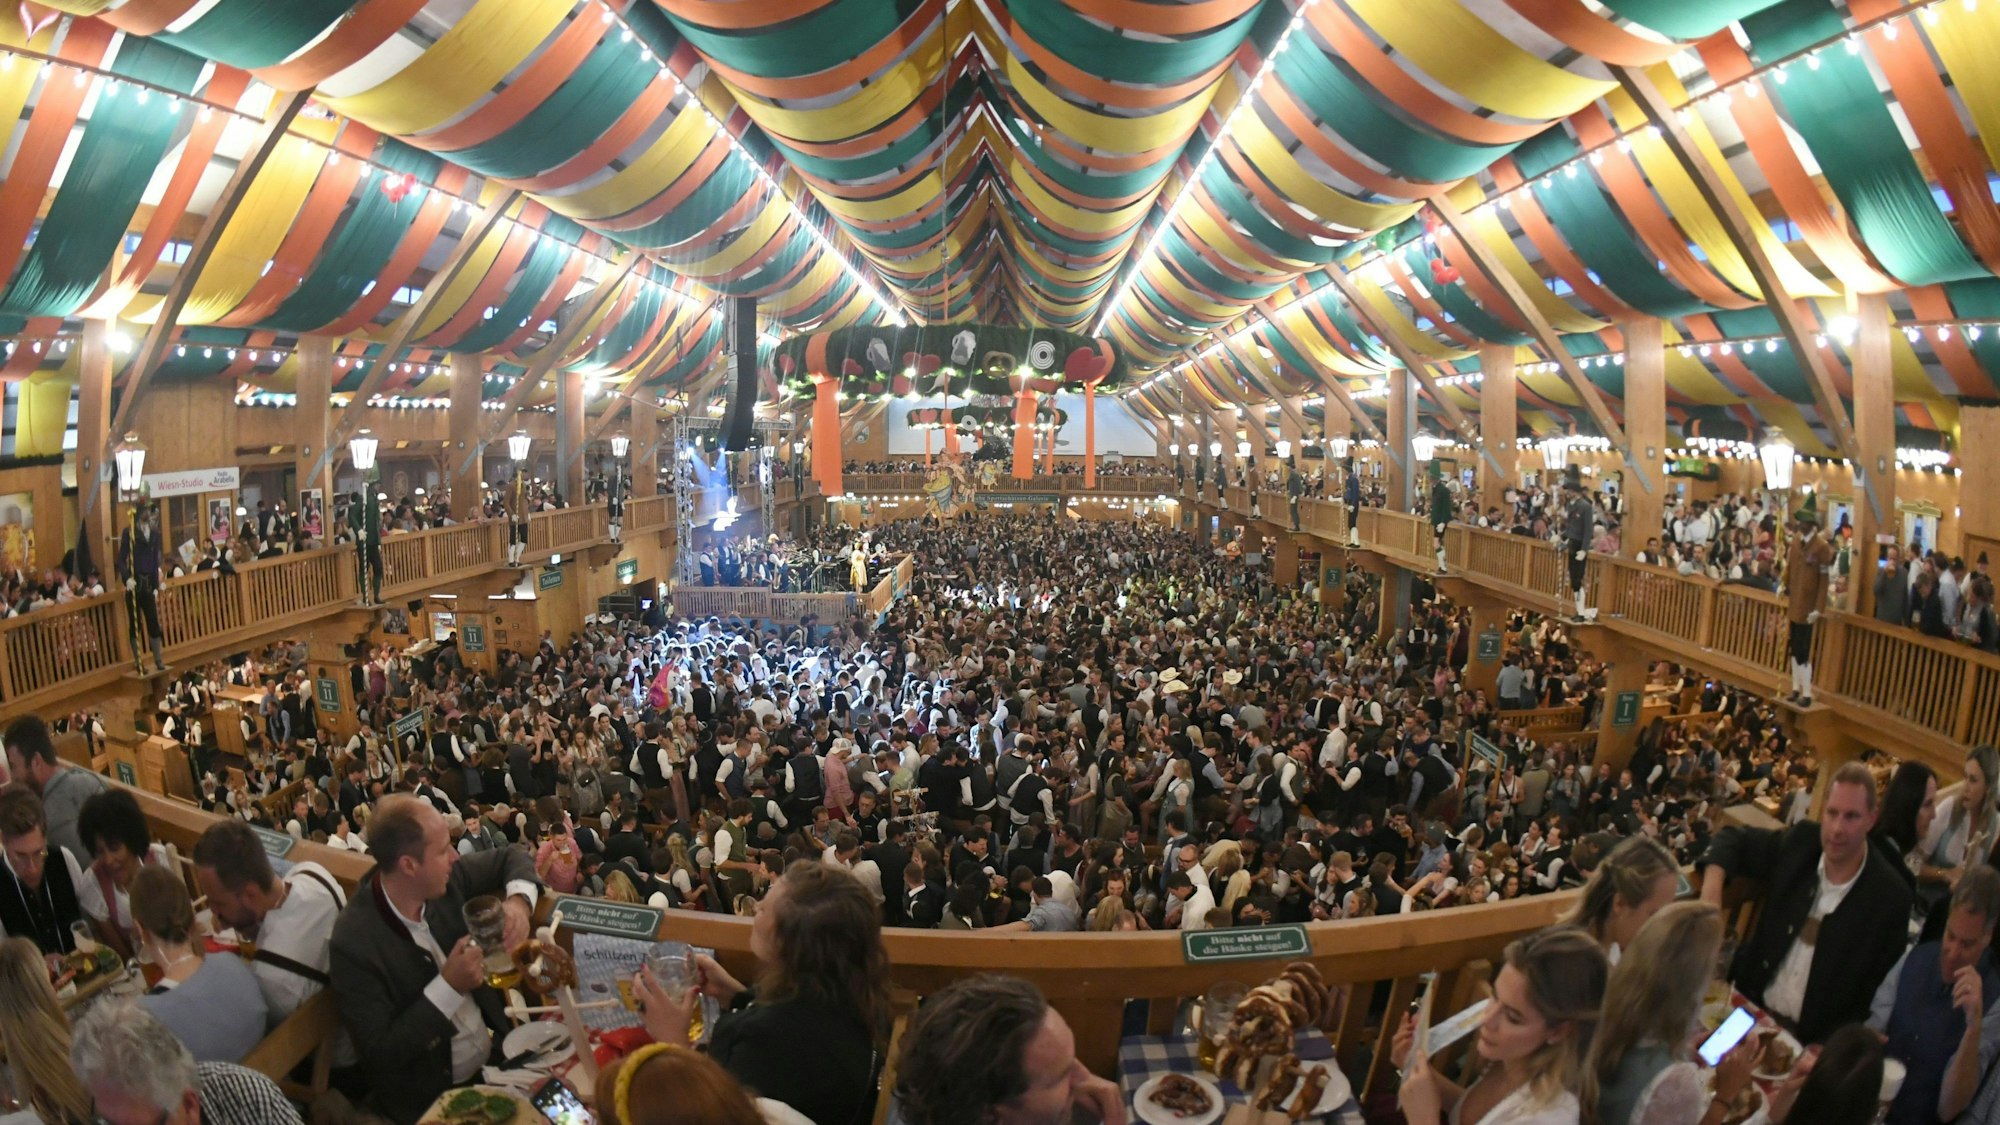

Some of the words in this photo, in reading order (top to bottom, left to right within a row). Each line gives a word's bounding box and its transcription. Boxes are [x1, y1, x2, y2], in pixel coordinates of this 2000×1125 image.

[158, 479, 203, 490] Wiesn-Studio
[214, 476, 234, 484] Arabella
[468, 633, 477, 643] 11
[1486, 641, 1493, 652] 2
[323, 688, 333, 700] 11
[1624, 703, 1629, 717] 1
[576, 904, 597, 914] Bitte
[597, 908, 621, 918] nicht
[622, 912, 639, 920] auf
[564, 911, 578, 920] die
[579, 914, 605, 925] Bänke
[607, 919, 641, 930] steigen!
[1210, 936, 1235, 945] Bitte
[1237, 934, 1263, 943] nicht
[1265, 932, 1281, 940] auf
[1203, 946, 1219, 955] die
[1221, 944, 1253, 953] Bänke
[1255, 941, 1292, 952] steigen!
[584, 949, 637, 961] Schützen
